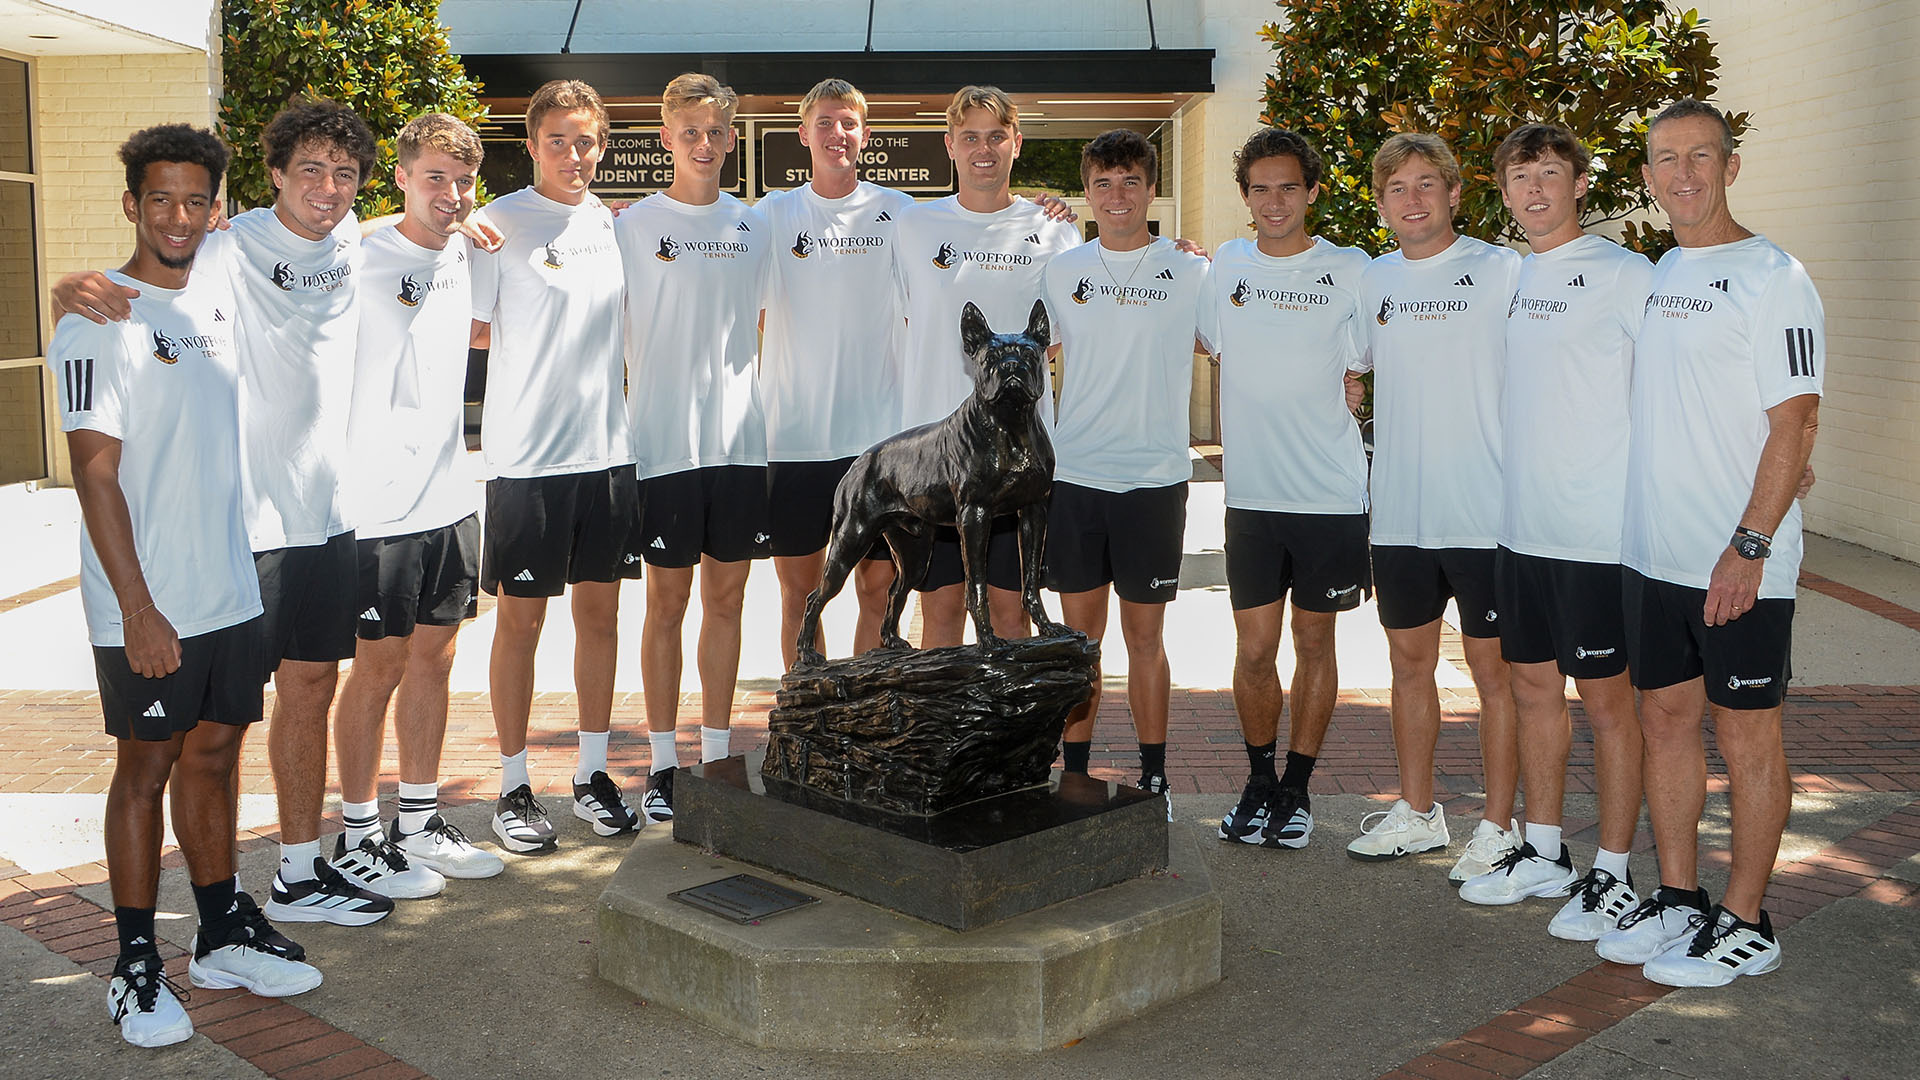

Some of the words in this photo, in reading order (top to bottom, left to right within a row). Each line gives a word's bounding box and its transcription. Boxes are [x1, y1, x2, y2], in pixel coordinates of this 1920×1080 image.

[606, 139, 651, 148] ELCOME
[887, 138, 909, 147] THE
[614, 153, 674, 165] MUNGO
[865, 168, 930, 181] CENTER
[684, 241, 748, 252] WOFFORD
[818, 236, 884, 248] WOFFORD
[963, 251, 1032, 265] WOFFORD
[979, 263, 1014, 271] TENNIS
[1100, 285, 1168, 301] WOFFORD
[1256, 289, 1329, 305] WOFFORD
[1273, 303, 1309, 311] TENNIS
[1399, 300, 1468, 313] WOFFORD
[1521, 298, 1568, 313] WOFFORD
[1653, 295, 1713, 313] WOFFORD
[1413, 313, 1447, 321] TENNIS
[1528, 312, 1550, 320] TENNIS
[1662, 310, 1688, 319] TENNIS
